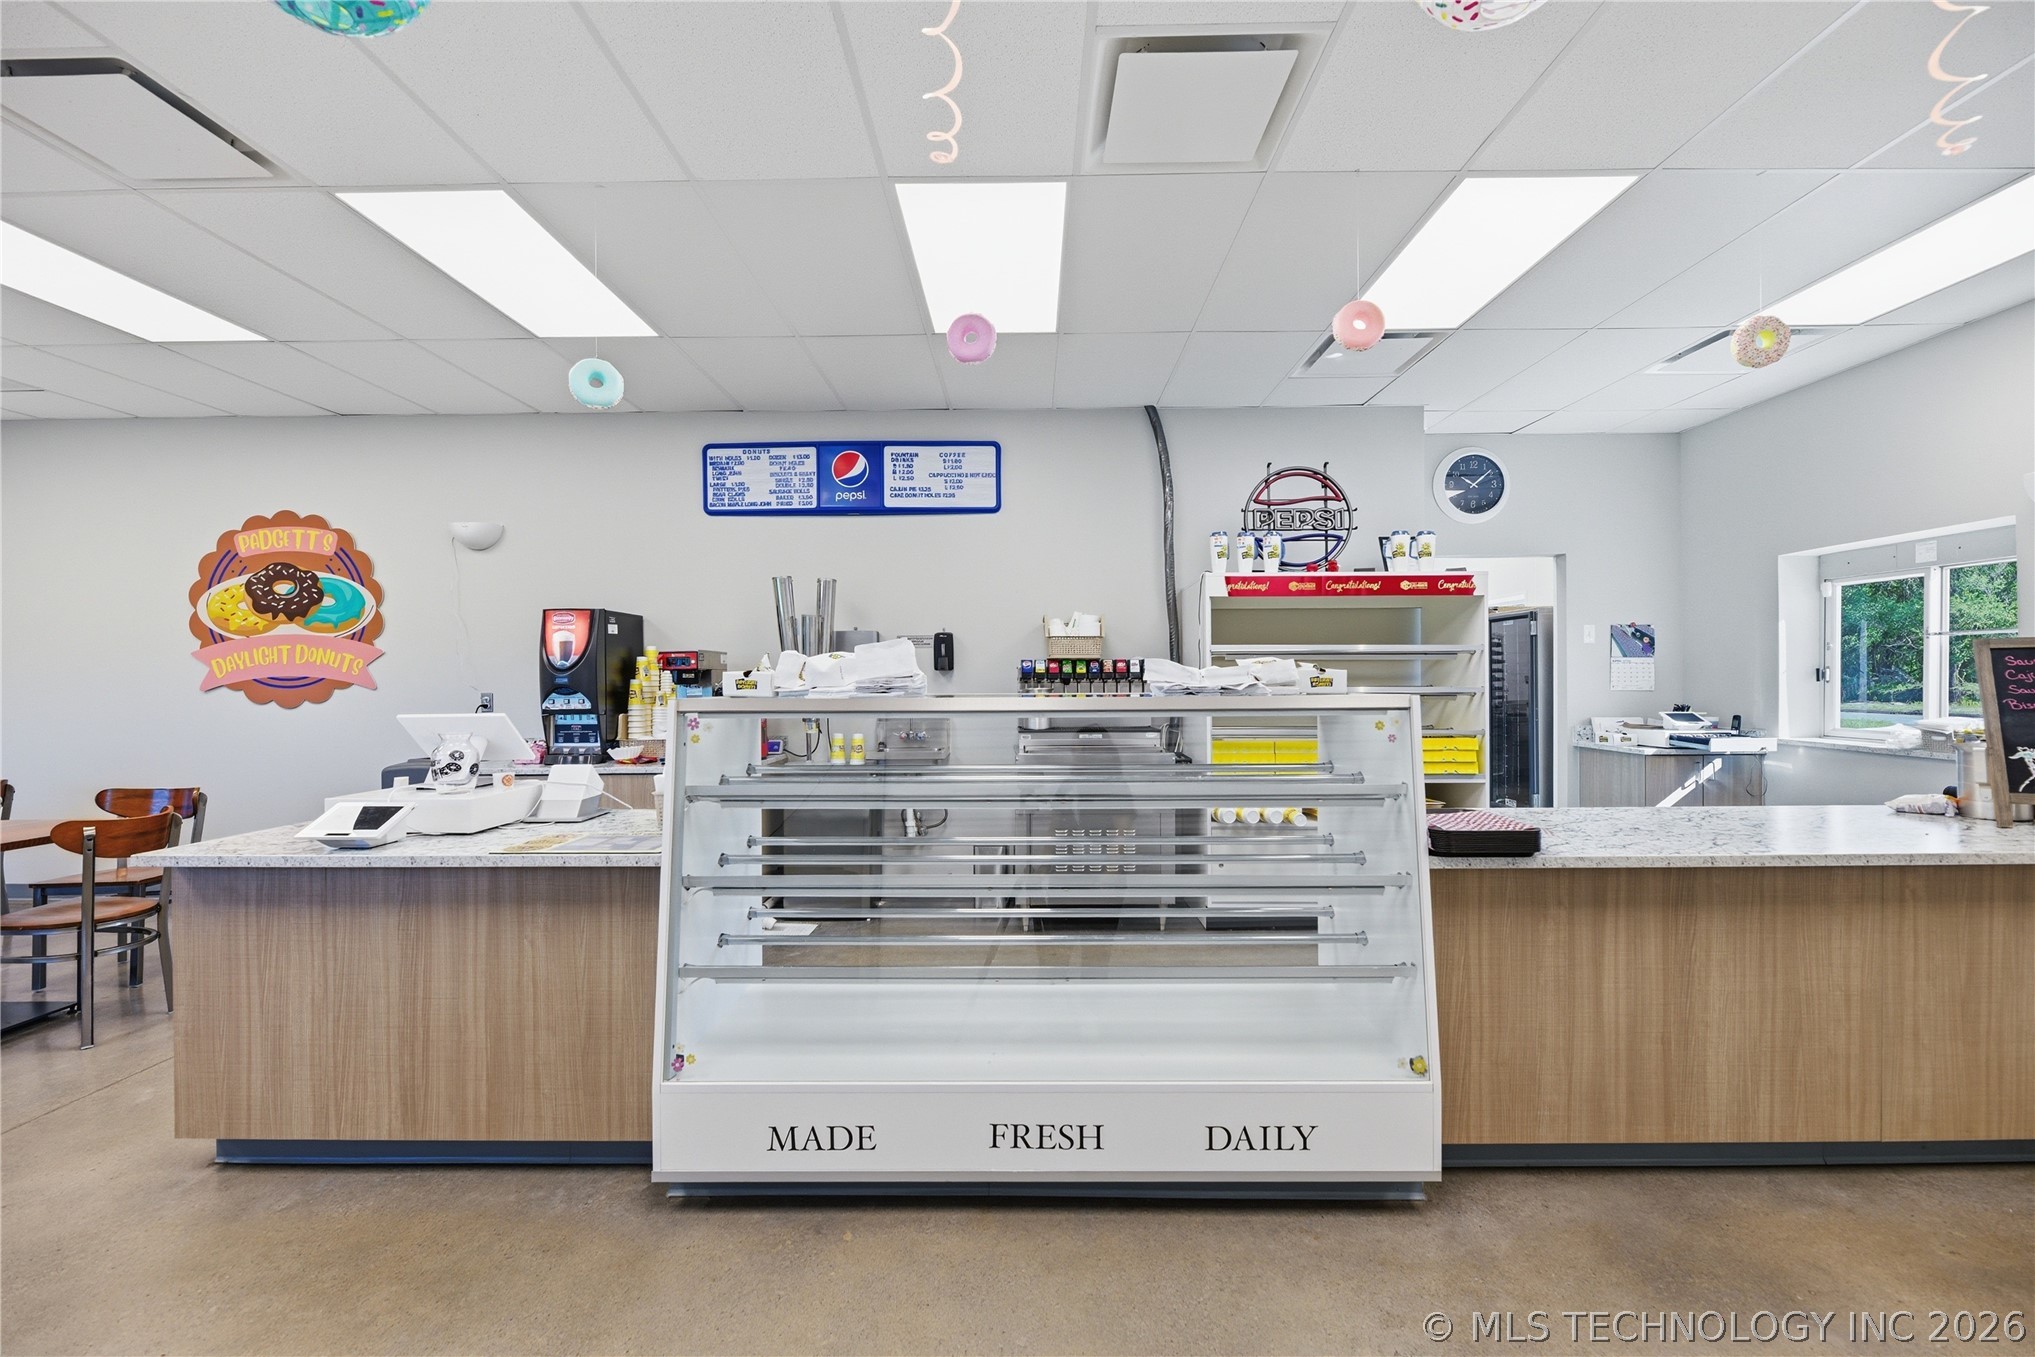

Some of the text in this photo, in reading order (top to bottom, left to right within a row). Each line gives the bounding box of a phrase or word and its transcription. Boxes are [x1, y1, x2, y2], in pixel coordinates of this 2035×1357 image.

[1469, 460, 1478, 469] 12
[1448, 480, 1454, 488] 9
[1491, 480, 1497, 488] 3
[835, 490, 866, 502] pepsi
[1470, 500, 1476, 508] 6
[1252, 507, 1345, 531] PEPSI
[237, 529, 334, 553] PADGETT'S
[1325, 580, 1382, 592] Congratulations!
[210, 644, 364, 679] DAYLIGHT DONUTS
[2005, 656, 2035, 666] Sau
[766, 1123, 1318, 1152] MADE FRESH DAILY
